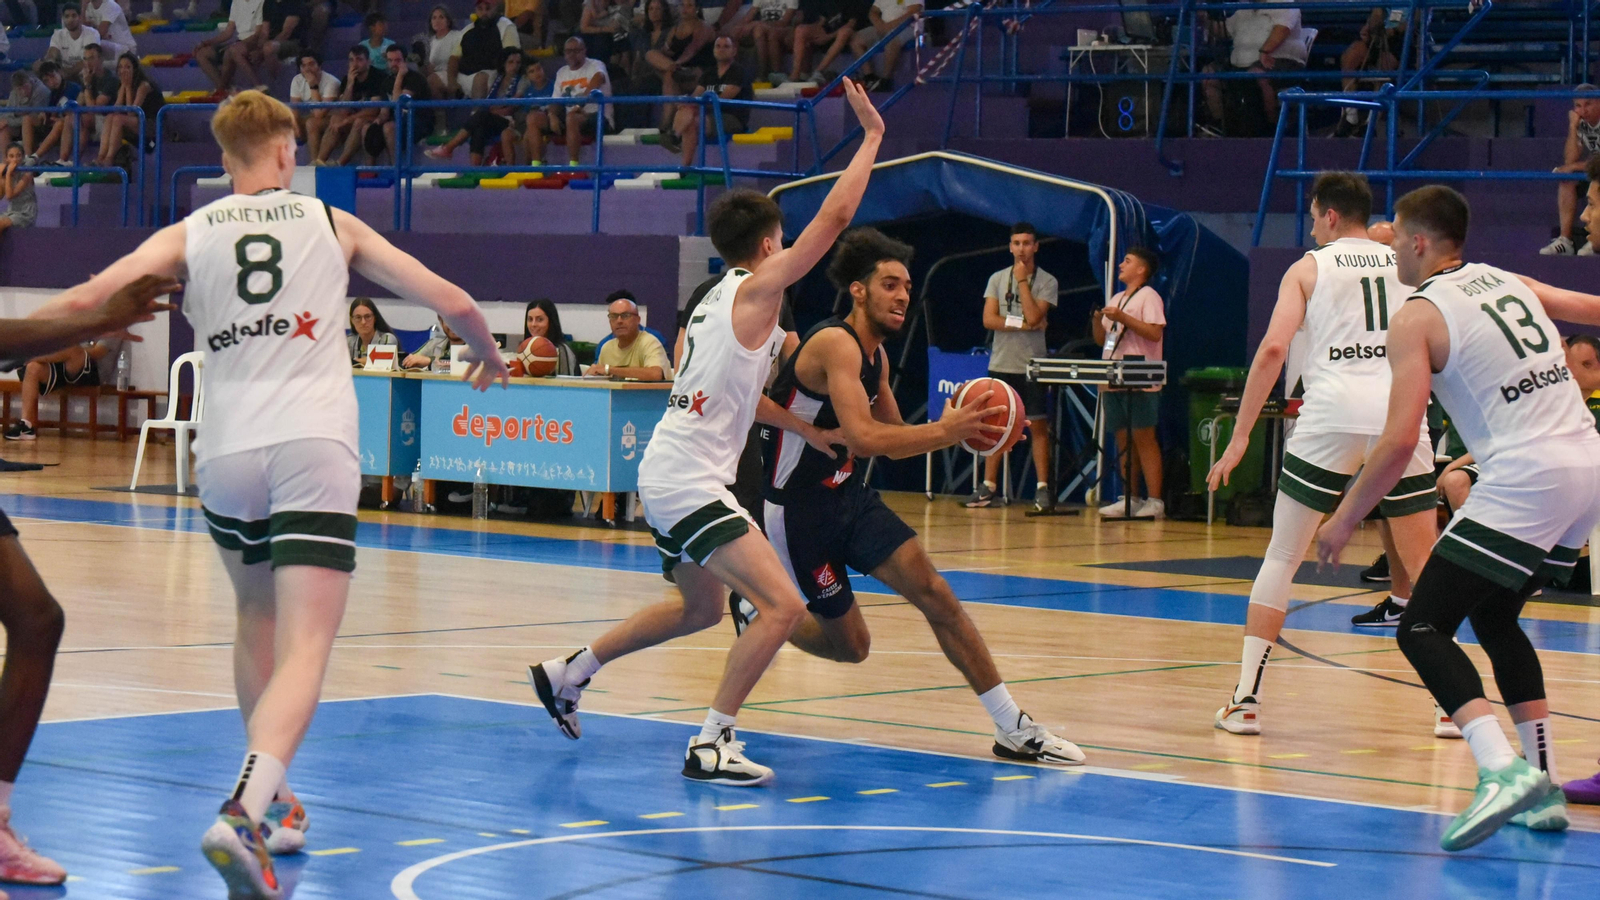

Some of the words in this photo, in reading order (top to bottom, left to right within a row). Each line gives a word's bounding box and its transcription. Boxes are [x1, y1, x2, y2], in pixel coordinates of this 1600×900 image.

[206, 203, 305, 226] VOKIETAITIS
[235, 233, 283, 305] 8
[1334, 253, 1397, 268] KIUDULAS
[1359, 276, 1388, 332] 11
[1456, 272, 1505, 297] BUTKA
[1481, 294, 1549, 360] 13
[1501, 363, 1569, 404] betsafe
[452, 404, 574, 447] deportes
